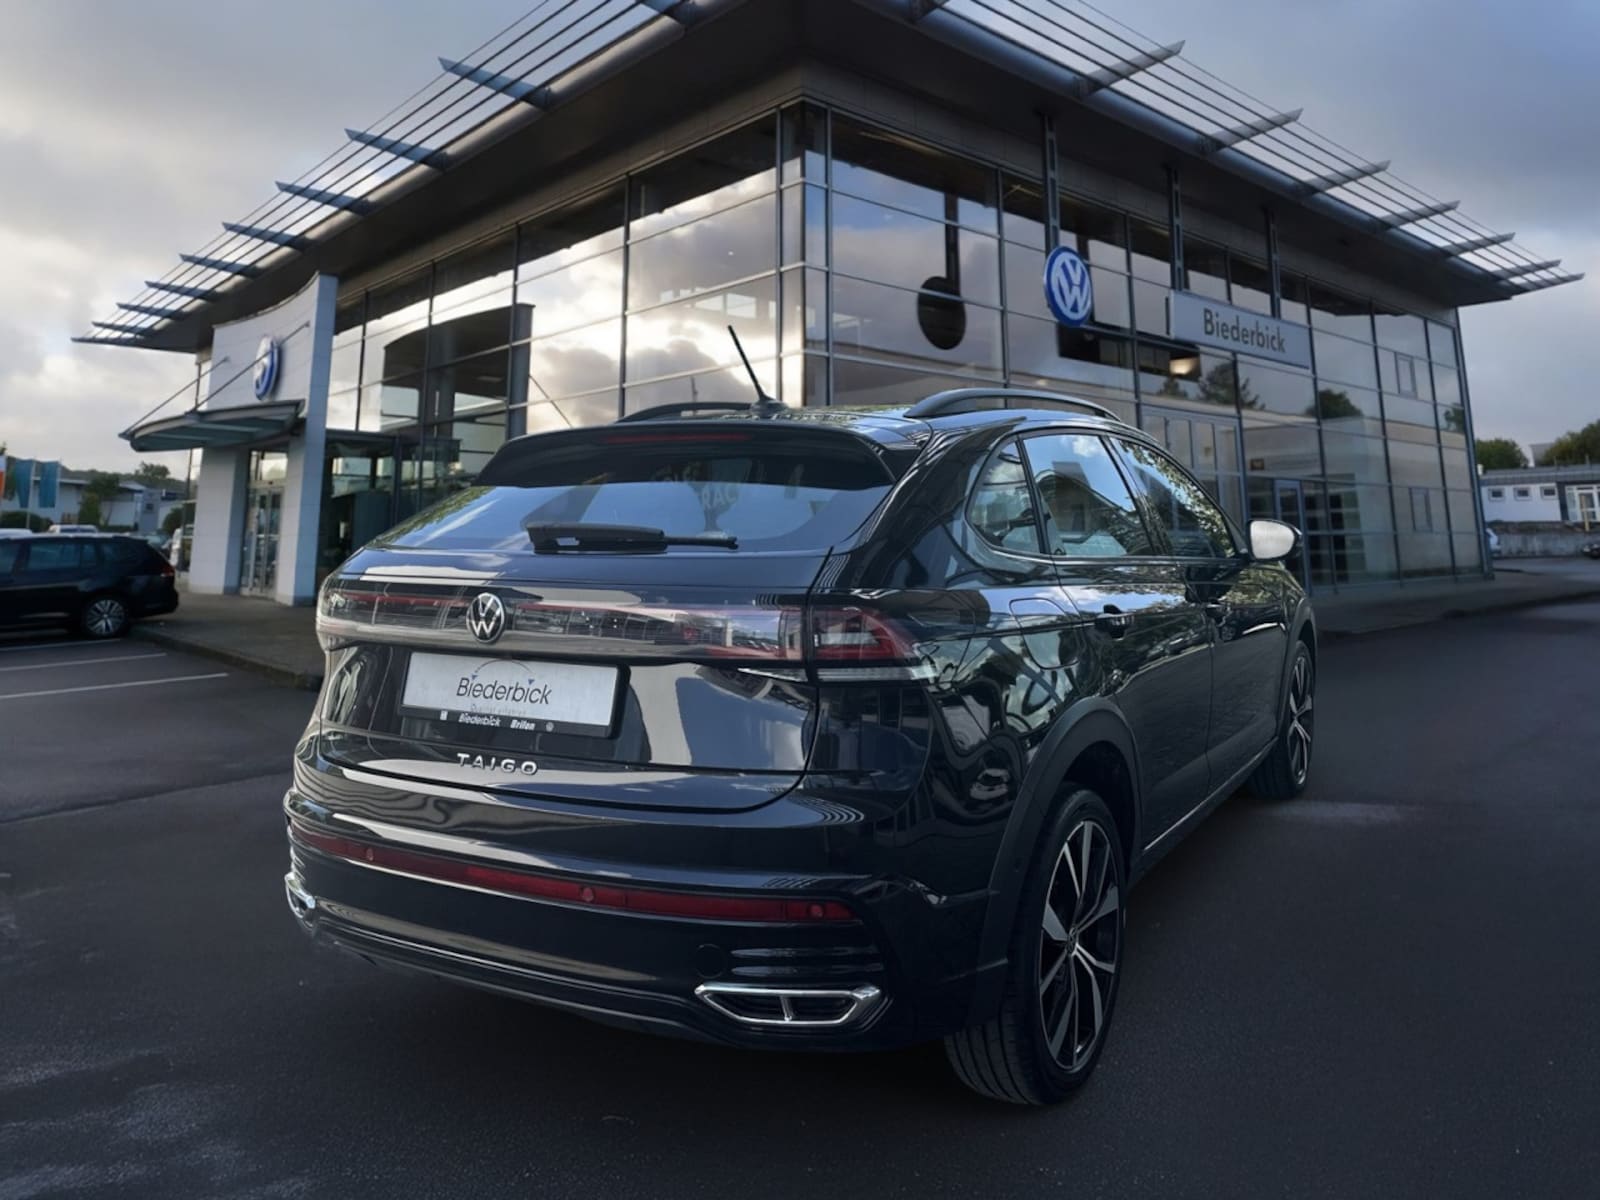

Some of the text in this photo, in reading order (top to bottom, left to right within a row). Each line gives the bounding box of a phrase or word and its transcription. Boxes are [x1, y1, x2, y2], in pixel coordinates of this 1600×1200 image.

[1203, 307, 1285, 353] Biederbick
[456, 676, 552, 705] Biederbick
[457, 752, 537, 775] TAIGO
